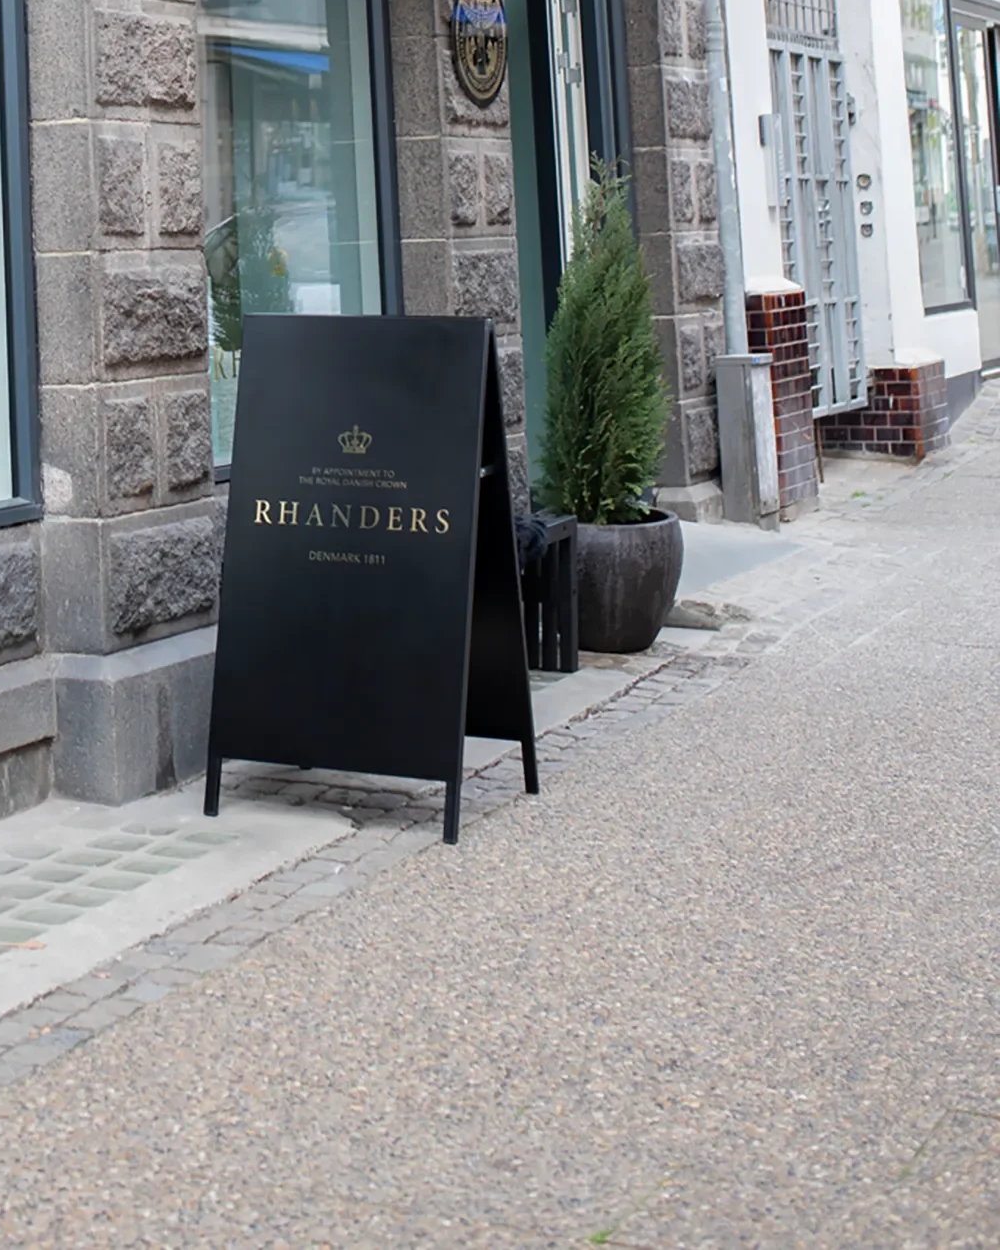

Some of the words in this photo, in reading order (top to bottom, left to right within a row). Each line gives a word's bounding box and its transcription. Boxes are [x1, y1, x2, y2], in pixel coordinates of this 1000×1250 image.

[323, 467, 381, 477] APPOINTMENT
[383, 469, 395, 478] TO
[298, 475, 314, 485] THE
[315, 476, 341, 486] ROYAL
[342, 478, 374, 488] DANISH
[375, 480, 408, 489] CROWN
[254, 499, 450, 534] RHANDERS
[308, 550, 362, 564] DENMARK
[364, 554, 385, 565] 1811
